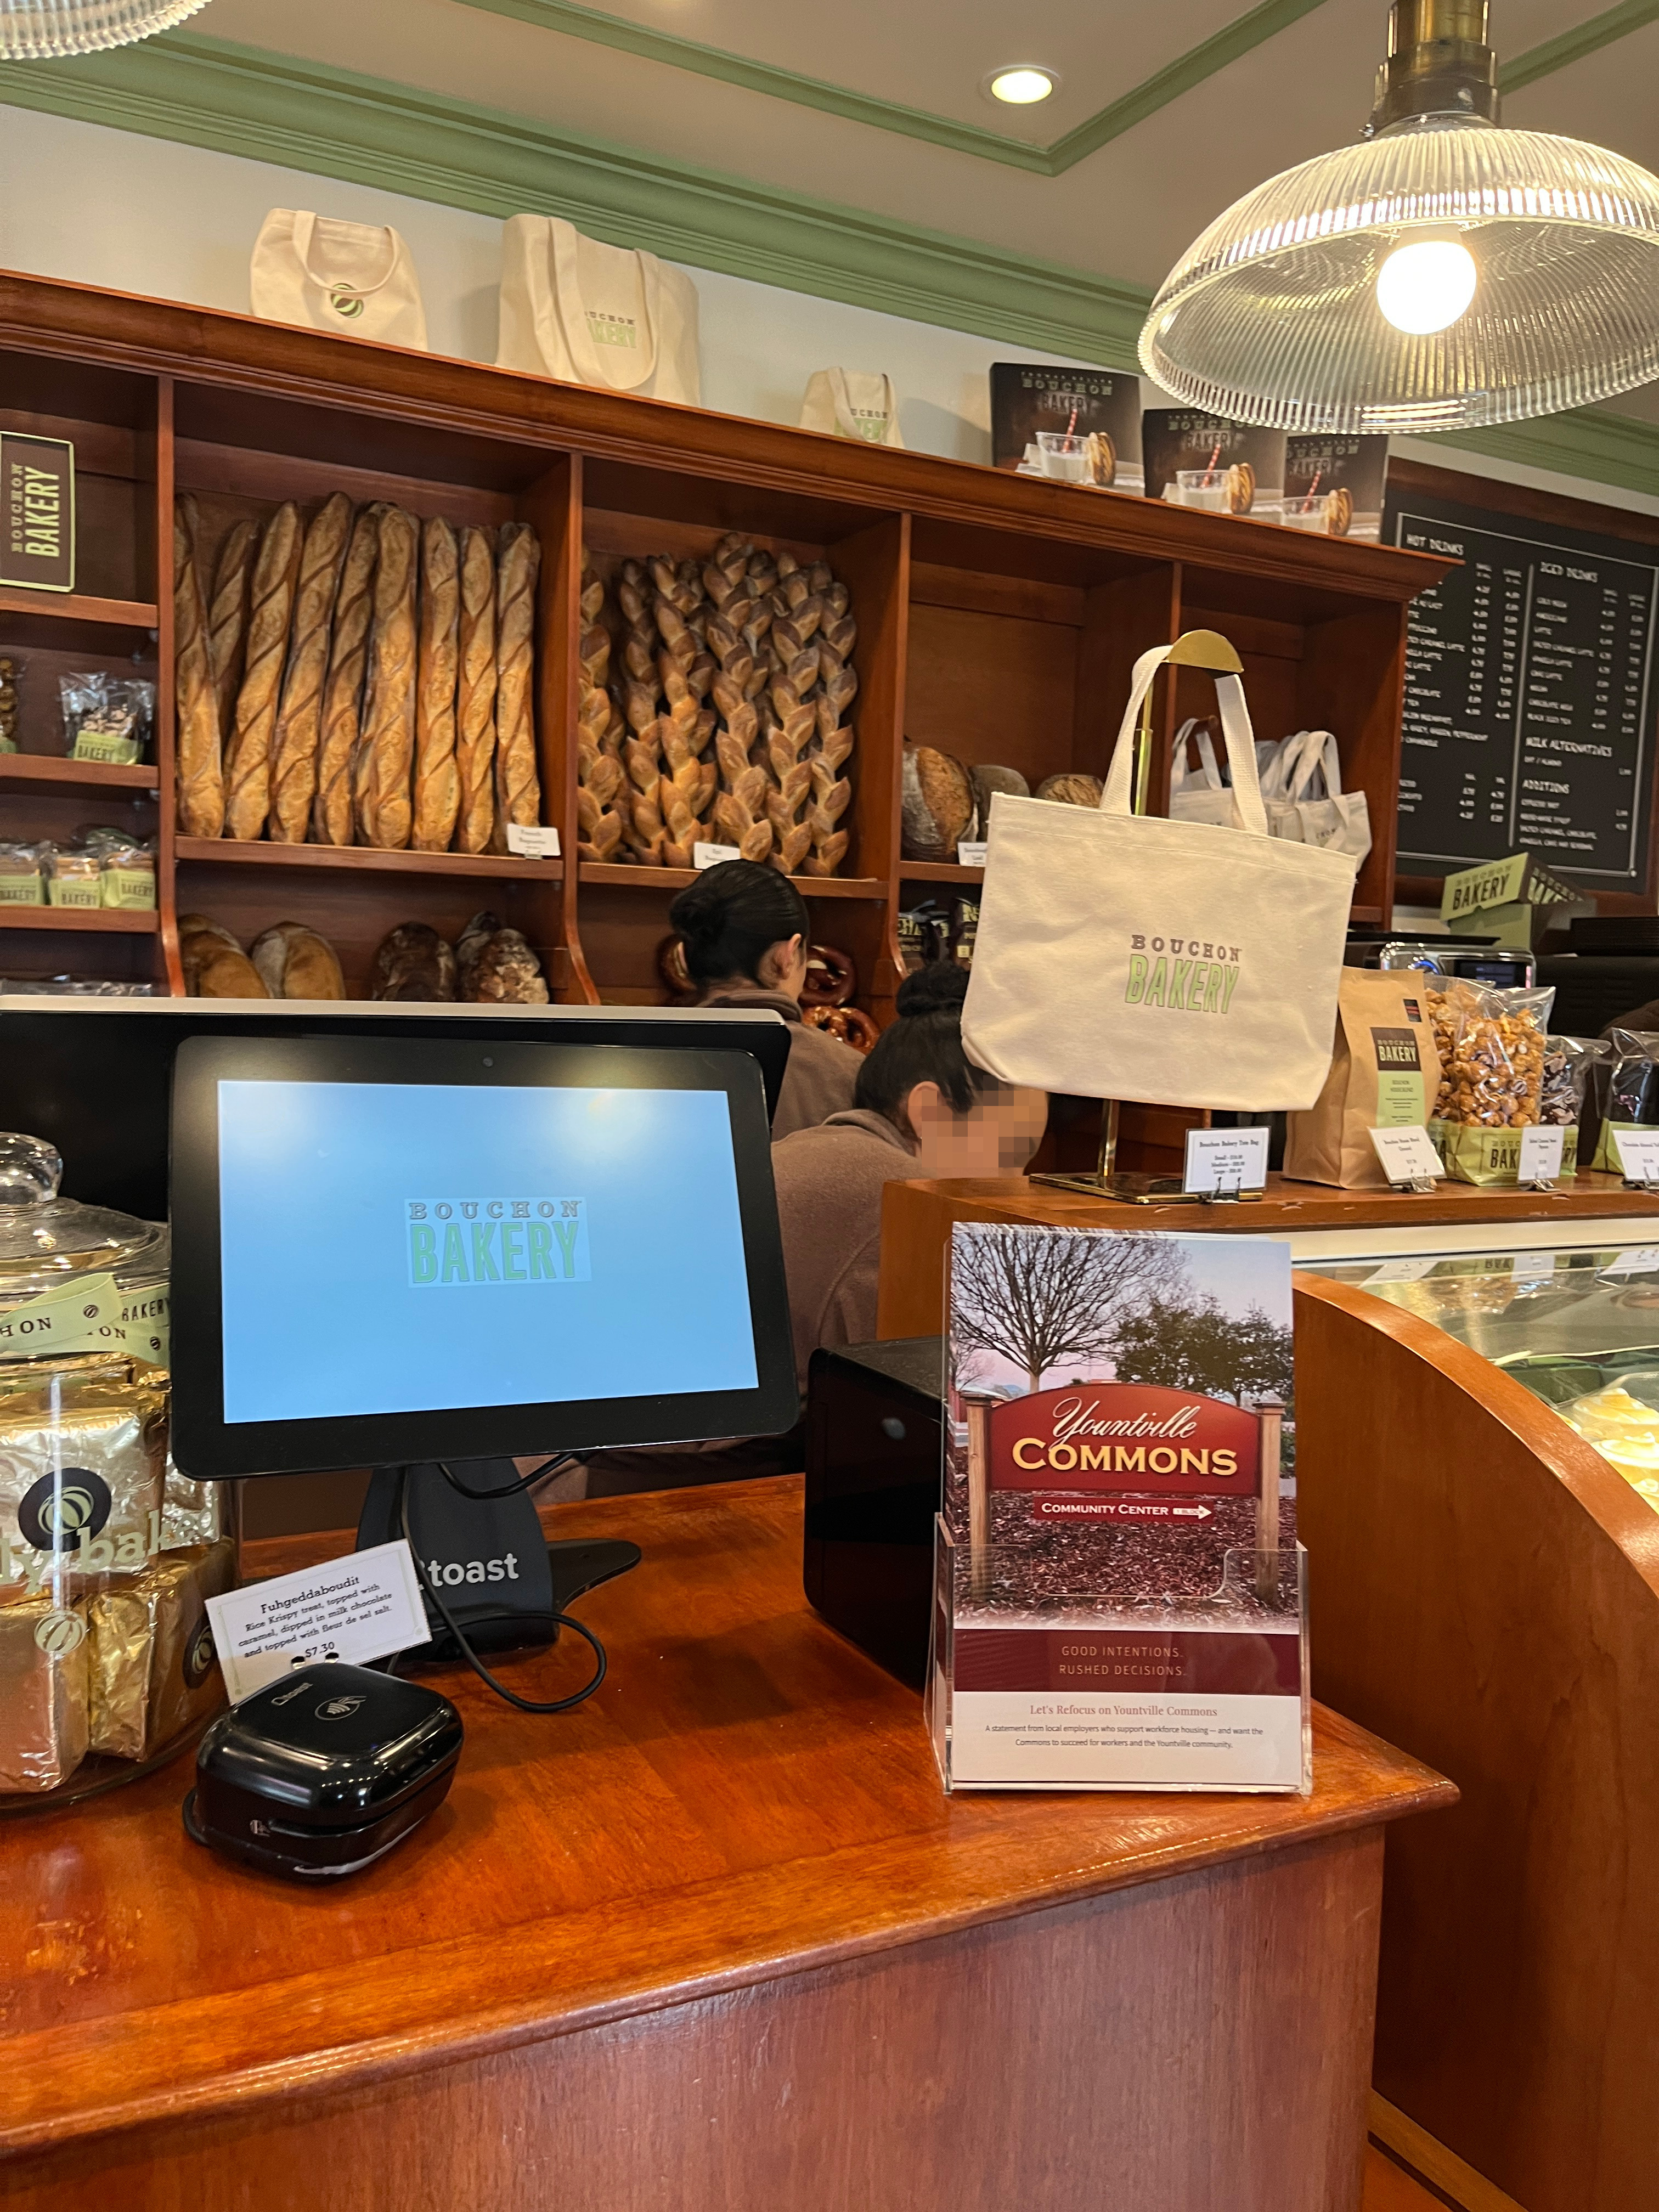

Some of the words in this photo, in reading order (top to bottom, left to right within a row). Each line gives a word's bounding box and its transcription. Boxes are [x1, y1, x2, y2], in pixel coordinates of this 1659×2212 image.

[1022, 378, 1113, 396] BOUCHON
[1168, 419, 1258, 431] BOUCHO
[10, 462, 23, 552] BOUCHON
[25, 466, 60, 557] BAKERY
[1453, 873, 1510, 910] BAKERY
[1131, 935, 1242, 962] BOUCHON
[1125, 953, 1240, 1014] BAKERY
[1378, 1046, 1417, 1062] BAKERY
[409, 1201, 580, 1220] BOUCHON
[410, 1221, 579, 1283] BAKERY
[122, 1298, 170, 1322] BAKER
[1049, 1397, 1201, 1452] Yountville
[1012, 1437, 1238, 1476] COMMONS
[1041, 1503, 1116, 1514] COMMUNITY
[1118, 1504, 1169, 1515] CENTER
[427, 1553, 520, 1587] toast
[246, 1621, 266, 1632] Rice
[268, 1610, 298, 1625] Krispy
[301, 1602, 324, 1613] treat,
[327, 1590, 358, 1606] topped
[360, 1583, 380, 1594] with
[261, 1576, 360, 1613] Fuhgeddaboudit
[238, 1629, 278, 1646] caramel,
[281, 1617, 313, 1633] dipped
[316, 1613, 325, 1622] in
[328, 1606, 348, 1618] milk
[351, 1593, 392, 1610] chocolate
[244, 1647, 261, 1658] and
[265, 1635, 297, 1650] topped
[300, 1628, 319, 1639] with
[323, 1621, 343, 1632] fleur
[346, 1616, 357, 1625] de
[360, 1610, 371, 1620] sel
[375, 1605, 392, 1616] salt.
[1062, 1646, 1097, 1656] GOOD
[1059, 1664, 1109, 1674] RUSHED
[1030, 1705, 1053, 1714] Let's
[1057, 1705, 1096, 1714] Refocus
[1114, 1705, 1164, 1716] Yountville
[1166, 1706, 1217, 1716] Commons
[1181, 1726, 1209, 1735] housing
[1192, 1741, 1233, 1749] community.
